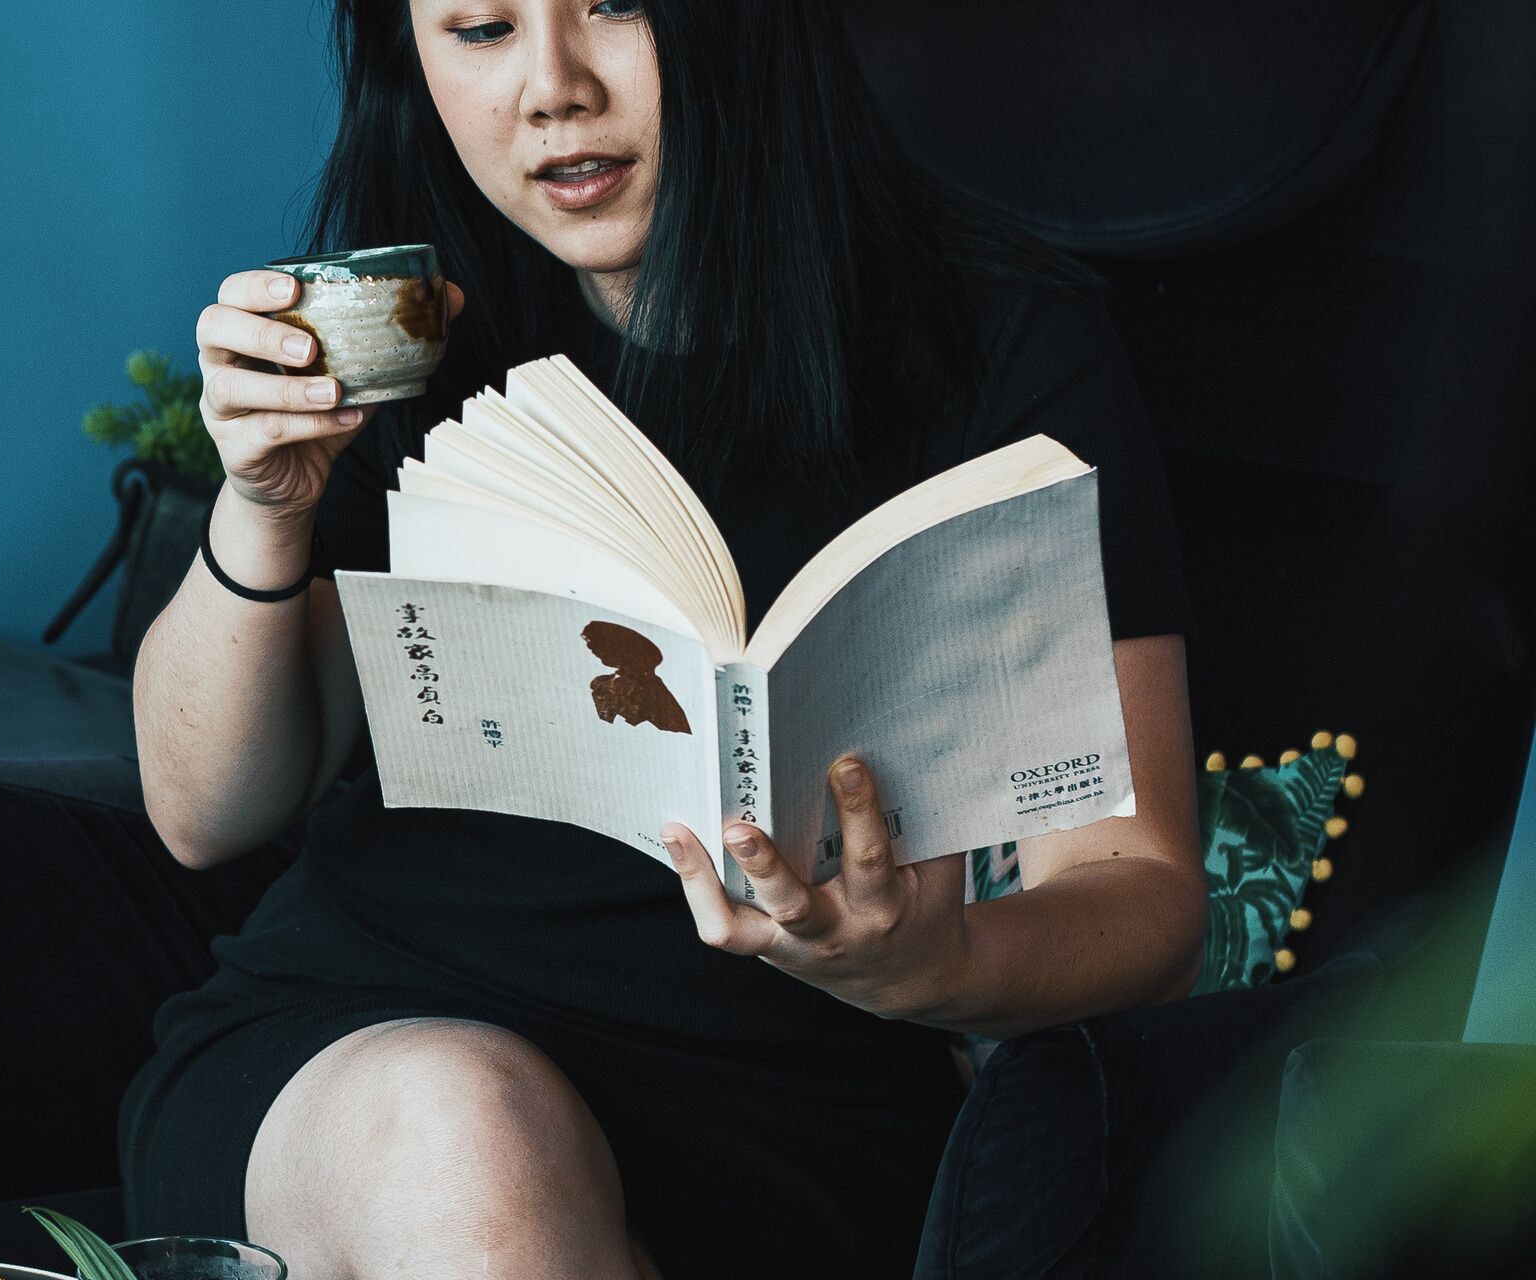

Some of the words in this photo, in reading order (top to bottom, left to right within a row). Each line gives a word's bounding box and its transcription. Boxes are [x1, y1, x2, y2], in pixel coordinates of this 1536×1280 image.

[1010, 753, 1101, 783] OXFORD
[1013, 773, 1070, 790] UNIVERSITY
[1073, 765, 1101, 777] PRESS
[1016, 776, 1104, 805] 牛津大學出版社
[1016, 789, 1105, 816] www.oupchina.com.hk
